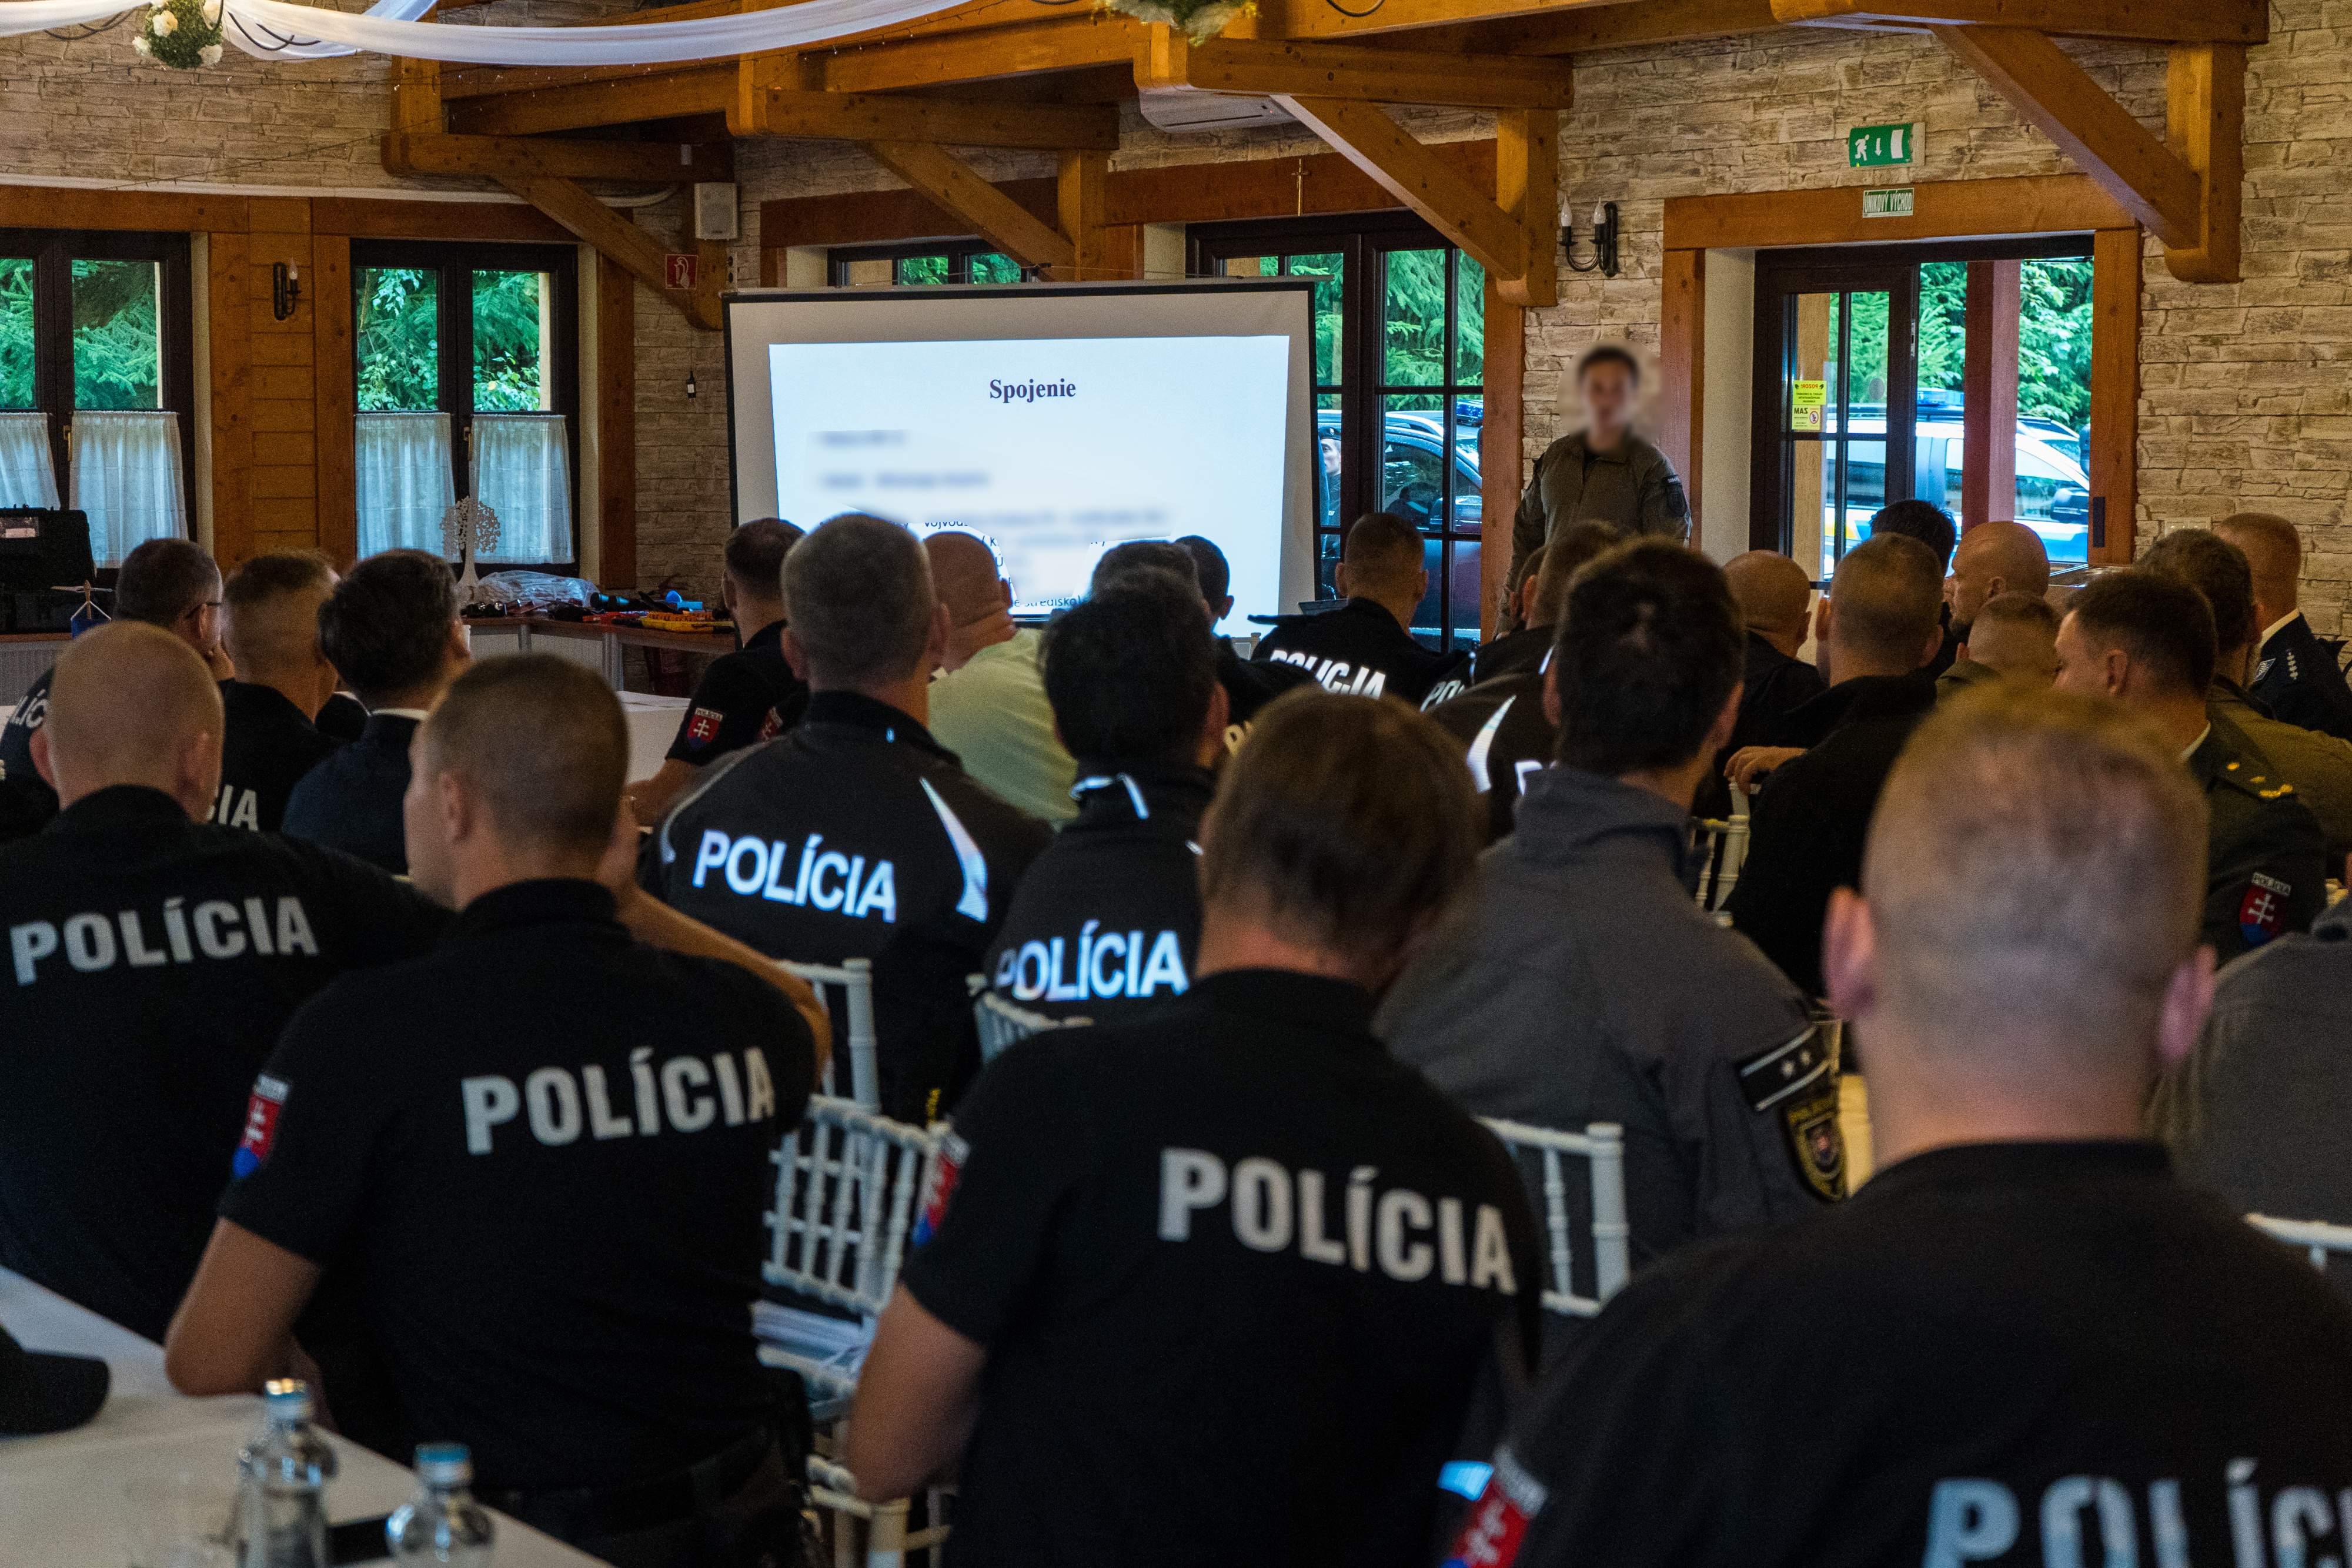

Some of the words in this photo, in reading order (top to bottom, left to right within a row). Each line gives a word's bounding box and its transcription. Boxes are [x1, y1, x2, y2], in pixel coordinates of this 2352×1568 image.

[1890, 189, 1912, 212] VÝCHOD
[990, 378, 1076, 403] Spojenie
[692, 829, 896, 922] POLÍCIA
[9, 896, 320, 985] POLÍCIA
[994, 918, 1190, 1002] POLÍCIA
[460, 1046, 776, 1155] POLÍCIA
[1157, 1146, 1519, 1295] POLÍCIA
